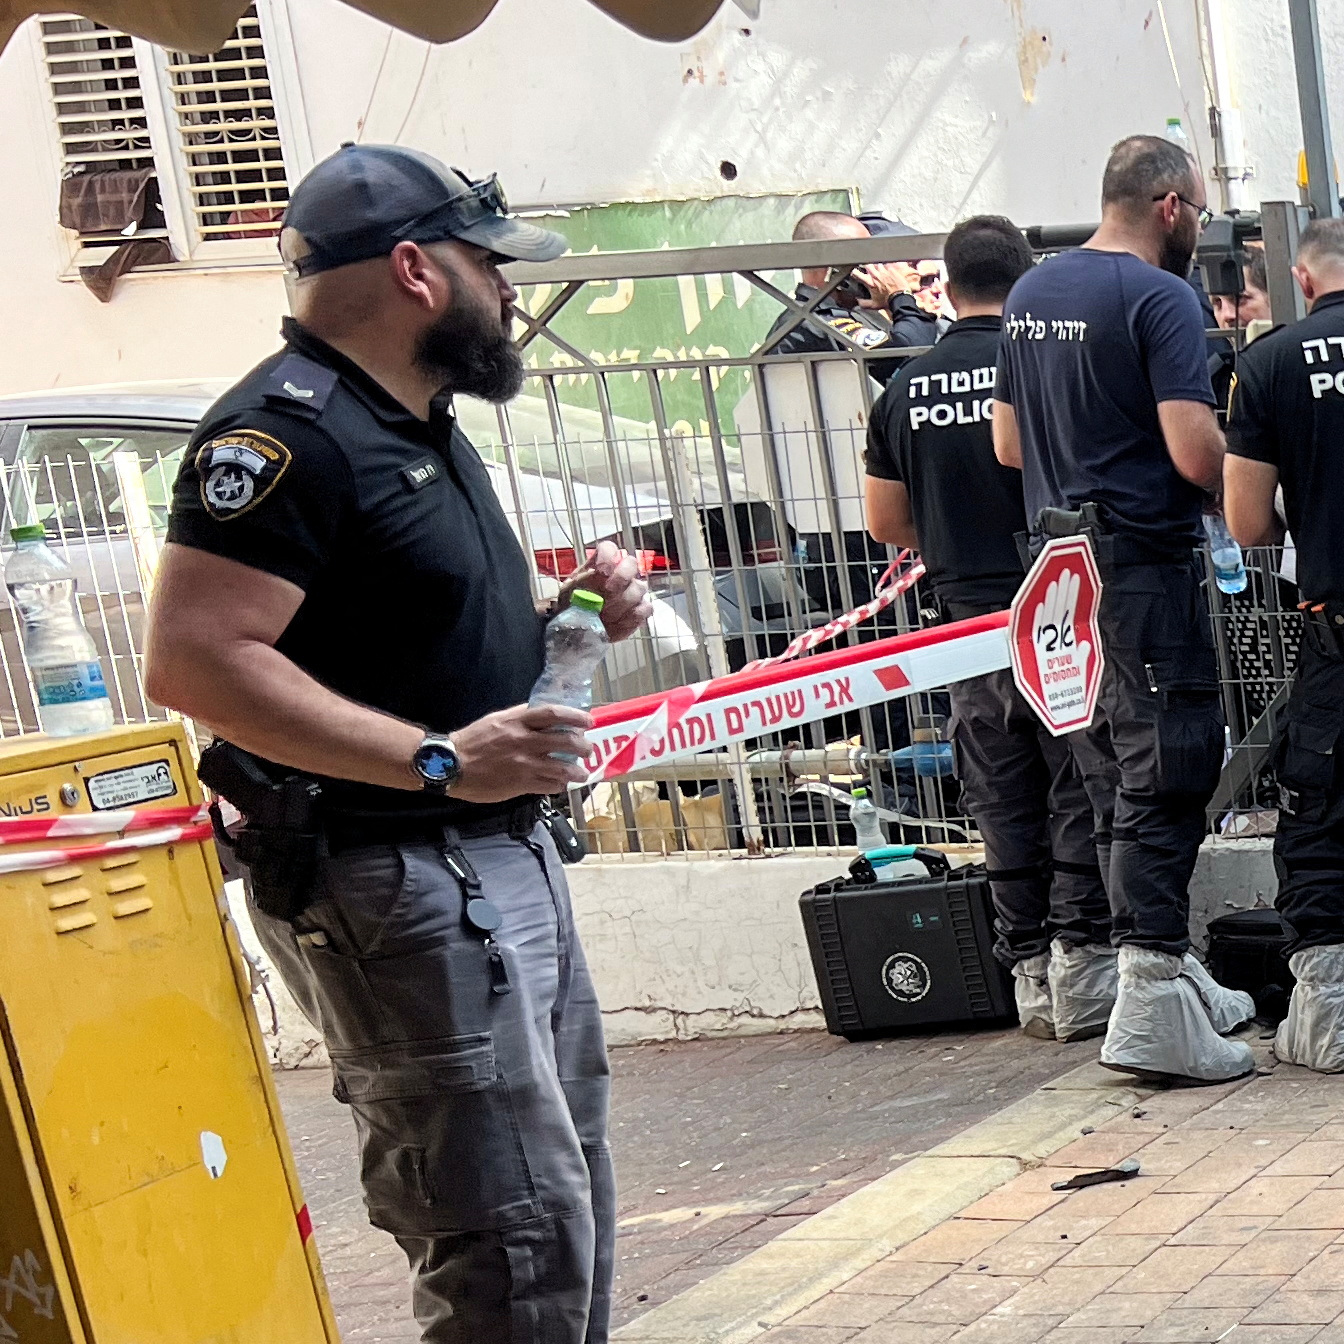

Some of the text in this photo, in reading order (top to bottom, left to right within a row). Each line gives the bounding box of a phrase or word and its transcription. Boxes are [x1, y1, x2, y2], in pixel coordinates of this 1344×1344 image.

[1006, 312, 1087, 342] זיהוי פלילי
[908, 366, 997, 399] שטרה
[908, 398, 994, 431] POLIC
[813, 676, 855, 709] אבי
[724, 689, 805, 736] שערים
